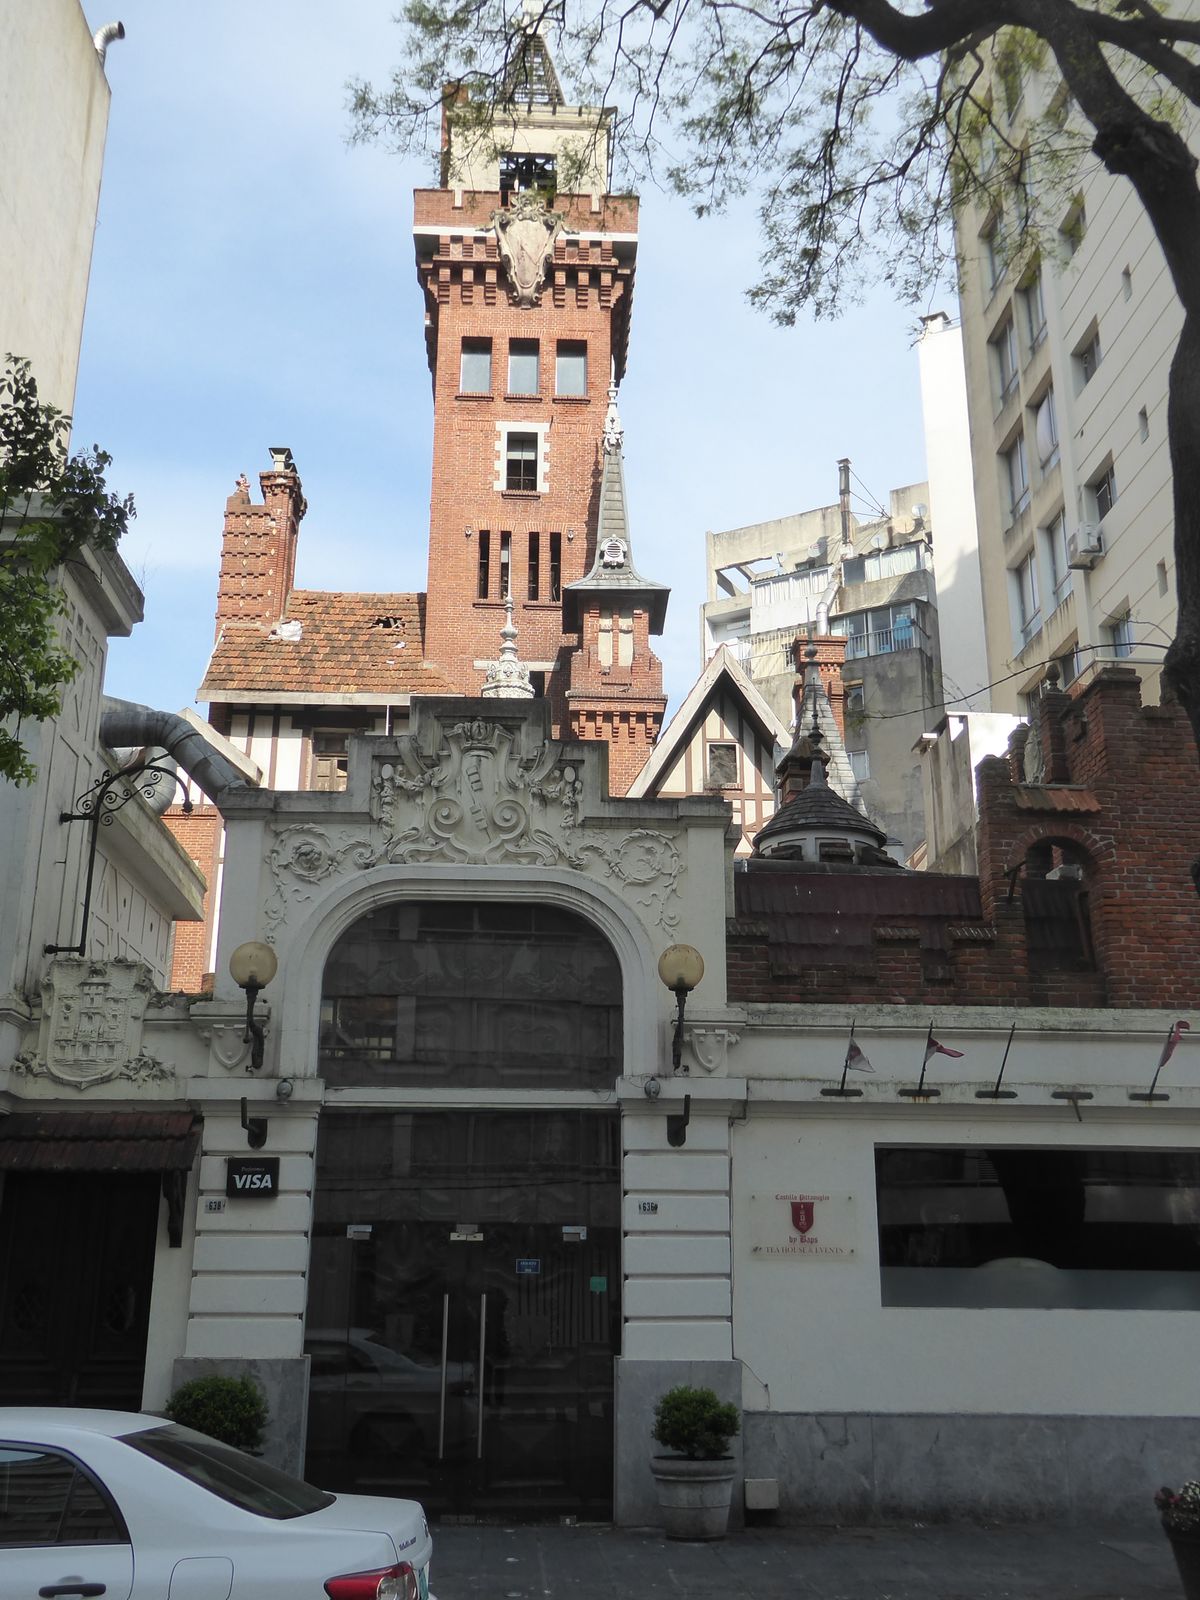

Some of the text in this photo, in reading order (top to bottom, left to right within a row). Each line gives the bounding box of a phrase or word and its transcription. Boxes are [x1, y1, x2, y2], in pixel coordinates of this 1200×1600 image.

[232, 1174, 273, 1189] VISA
[642, 1202, 655, 1212] 636
[766, 1246, 780, 1254] TEA
[781, 1246, 807, 1254] HOUSE
[815, 1246, 844, 1254] EVENTS
